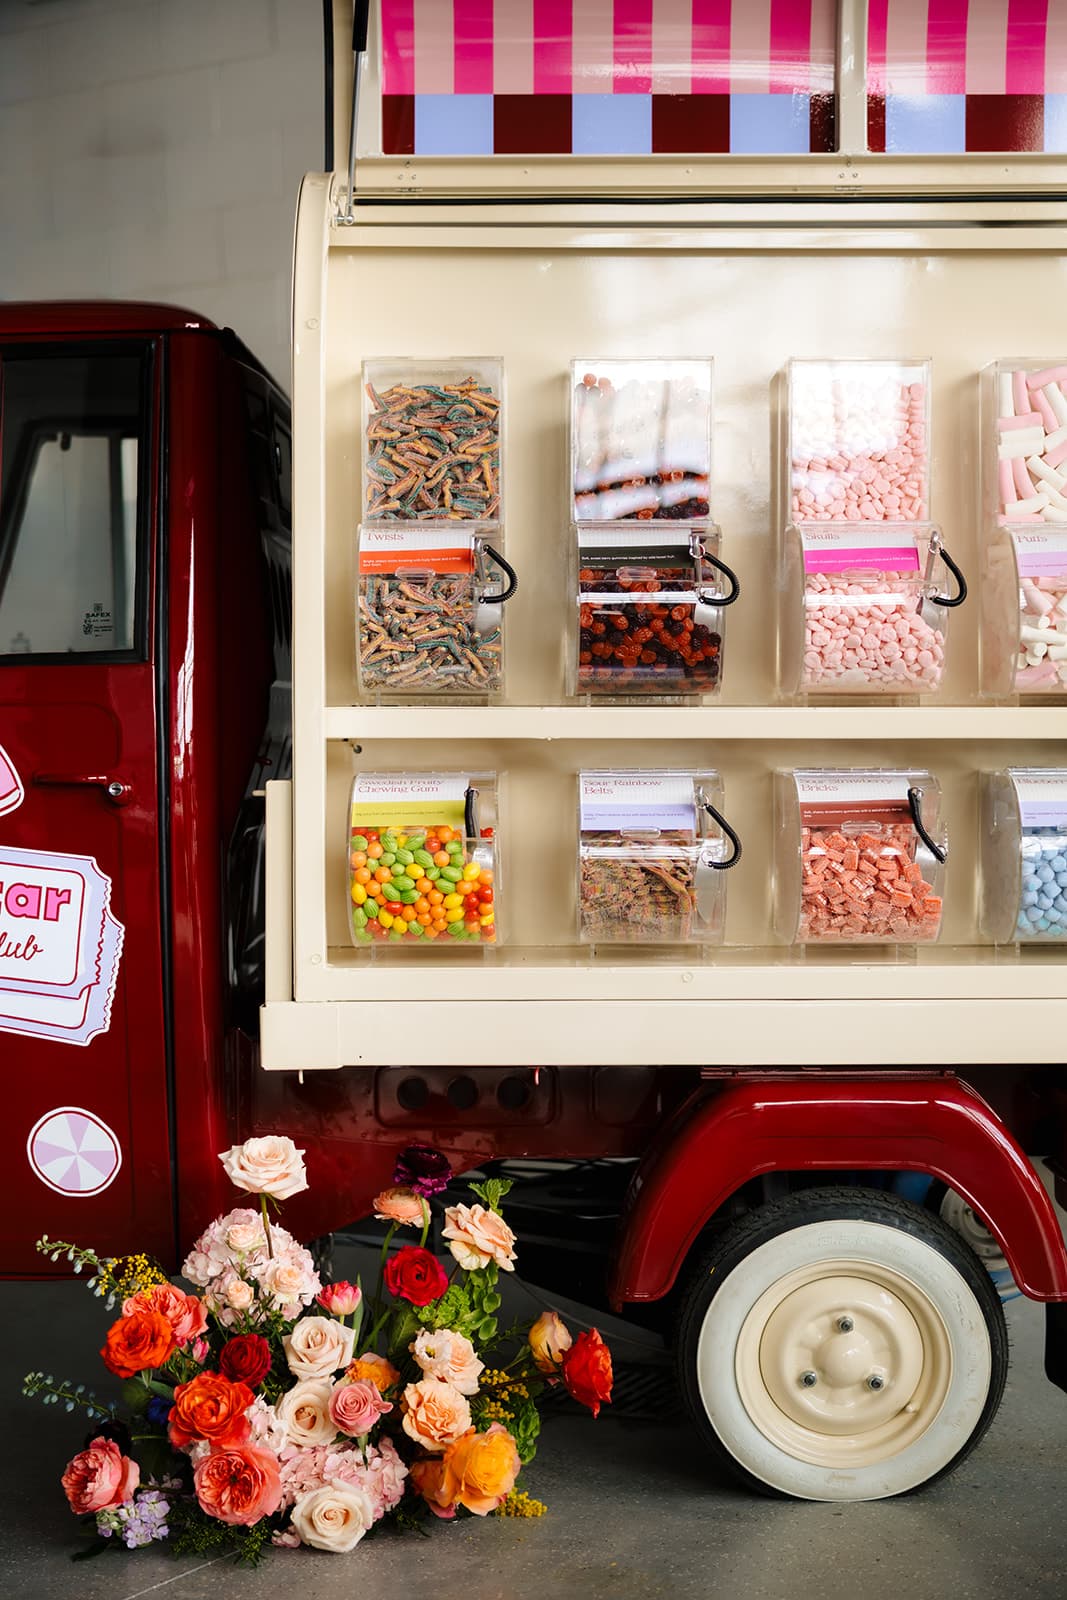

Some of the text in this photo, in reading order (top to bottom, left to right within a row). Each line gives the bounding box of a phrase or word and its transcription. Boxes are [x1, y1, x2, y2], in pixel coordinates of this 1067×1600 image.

[367, 532, 404, 541] Twists
[358, 785, 439, 794] Chewing Gum
[584, 786, 614, 795] Belts
[0, 881, 72, 922] ar
